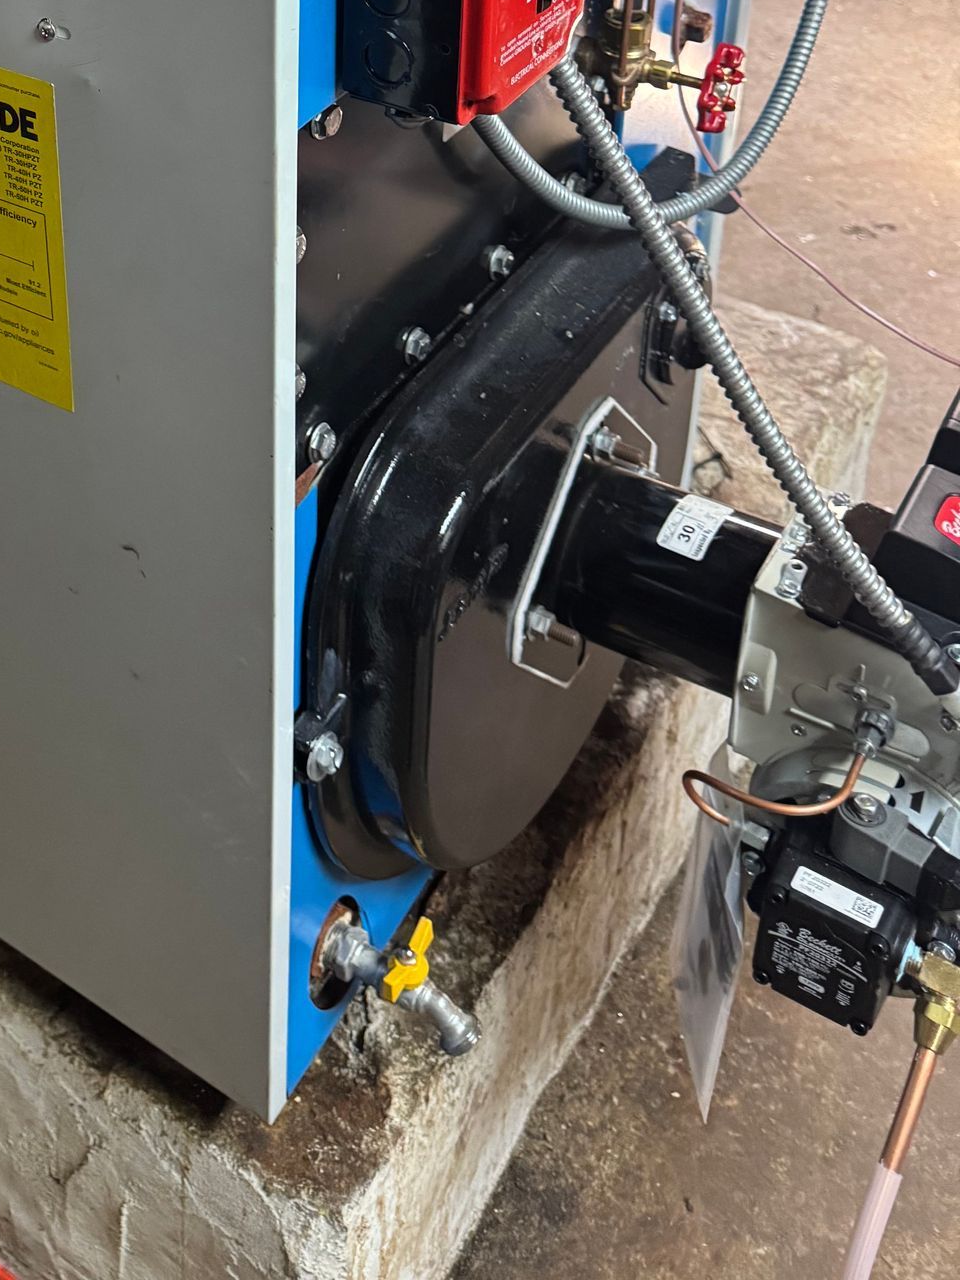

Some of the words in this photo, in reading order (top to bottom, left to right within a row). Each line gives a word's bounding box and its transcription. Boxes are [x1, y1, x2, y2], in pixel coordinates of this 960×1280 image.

[0, 136, 40, 155] Corporation
[21, 324, 30, 335] by
[678, 524, 696, 543] 30
